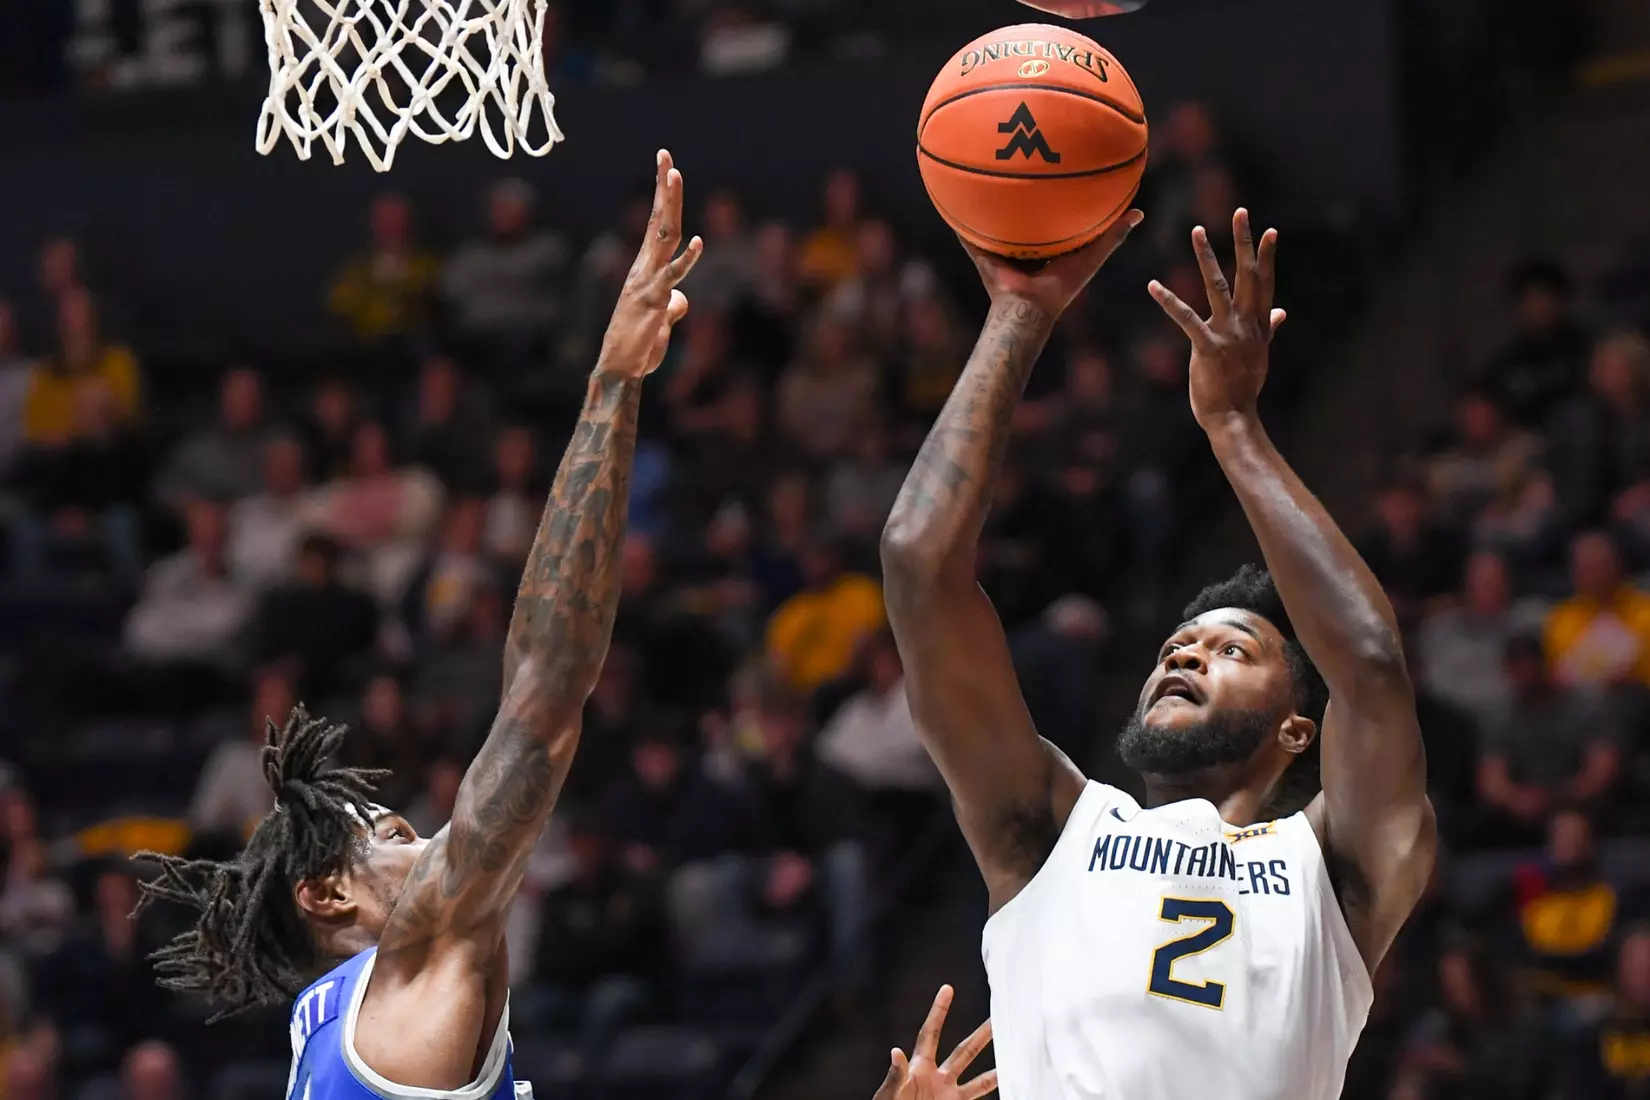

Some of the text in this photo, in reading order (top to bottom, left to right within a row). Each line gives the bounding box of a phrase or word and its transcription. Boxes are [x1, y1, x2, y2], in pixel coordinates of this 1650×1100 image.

[960, 40, 1109, 83] SPALDING
[1088, 834, 1291, 896] MOUNTAINERS
[1146, 895, 1237, 1011] 2
